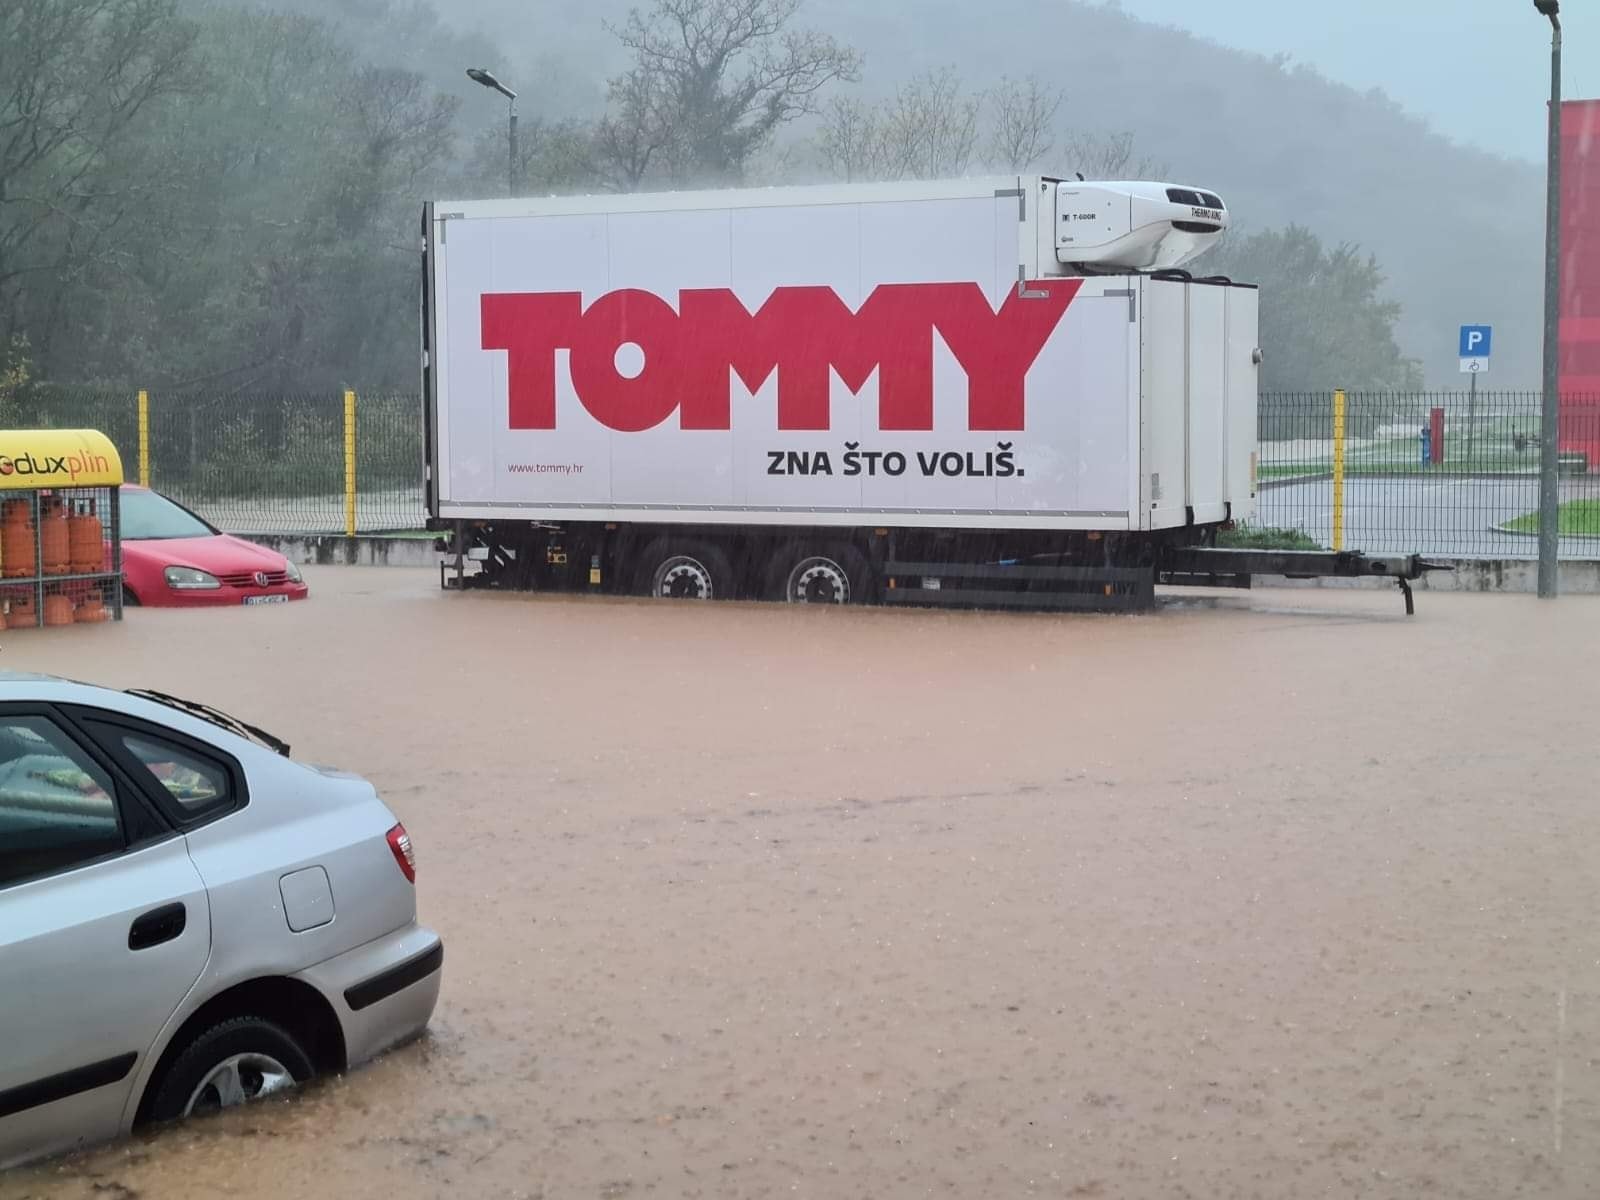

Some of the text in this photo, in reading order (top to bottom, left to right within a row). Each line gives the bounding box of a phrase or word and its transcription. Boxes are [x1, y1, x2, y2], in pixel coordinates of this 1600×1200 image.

[1468, 331, 1482, 350] P
[481, 278, 1085, 432] TOMMY
[508, 463, 584, 476] www.tommy.hr
[767, 441, 1025, 477] ZNA ŠTO VOLIŠ.
